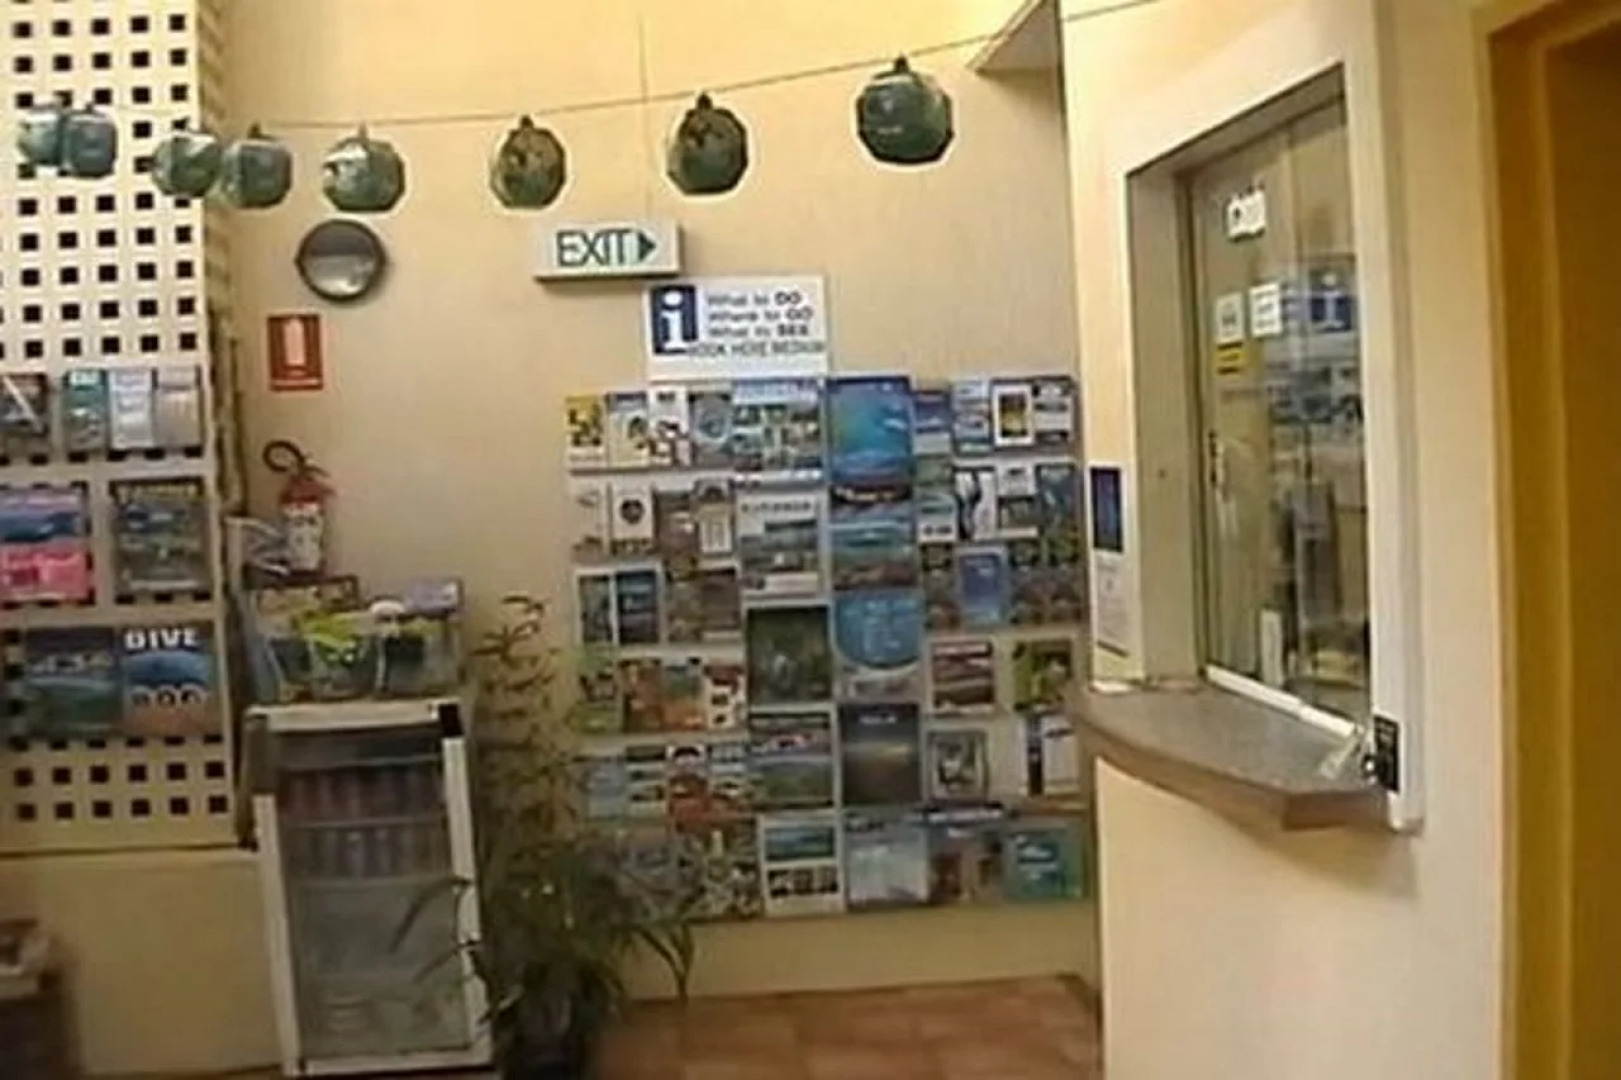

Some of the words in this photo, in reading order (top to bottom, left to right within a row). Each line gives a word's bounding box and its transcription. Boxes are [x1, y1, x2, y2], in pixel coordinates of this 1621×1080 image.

[557, 228, 632, 267] EXIT
[773, 290, 802, 306] DO
[785, 305, 814, 320] GO
[125, 627, 201, 650] DIVE
